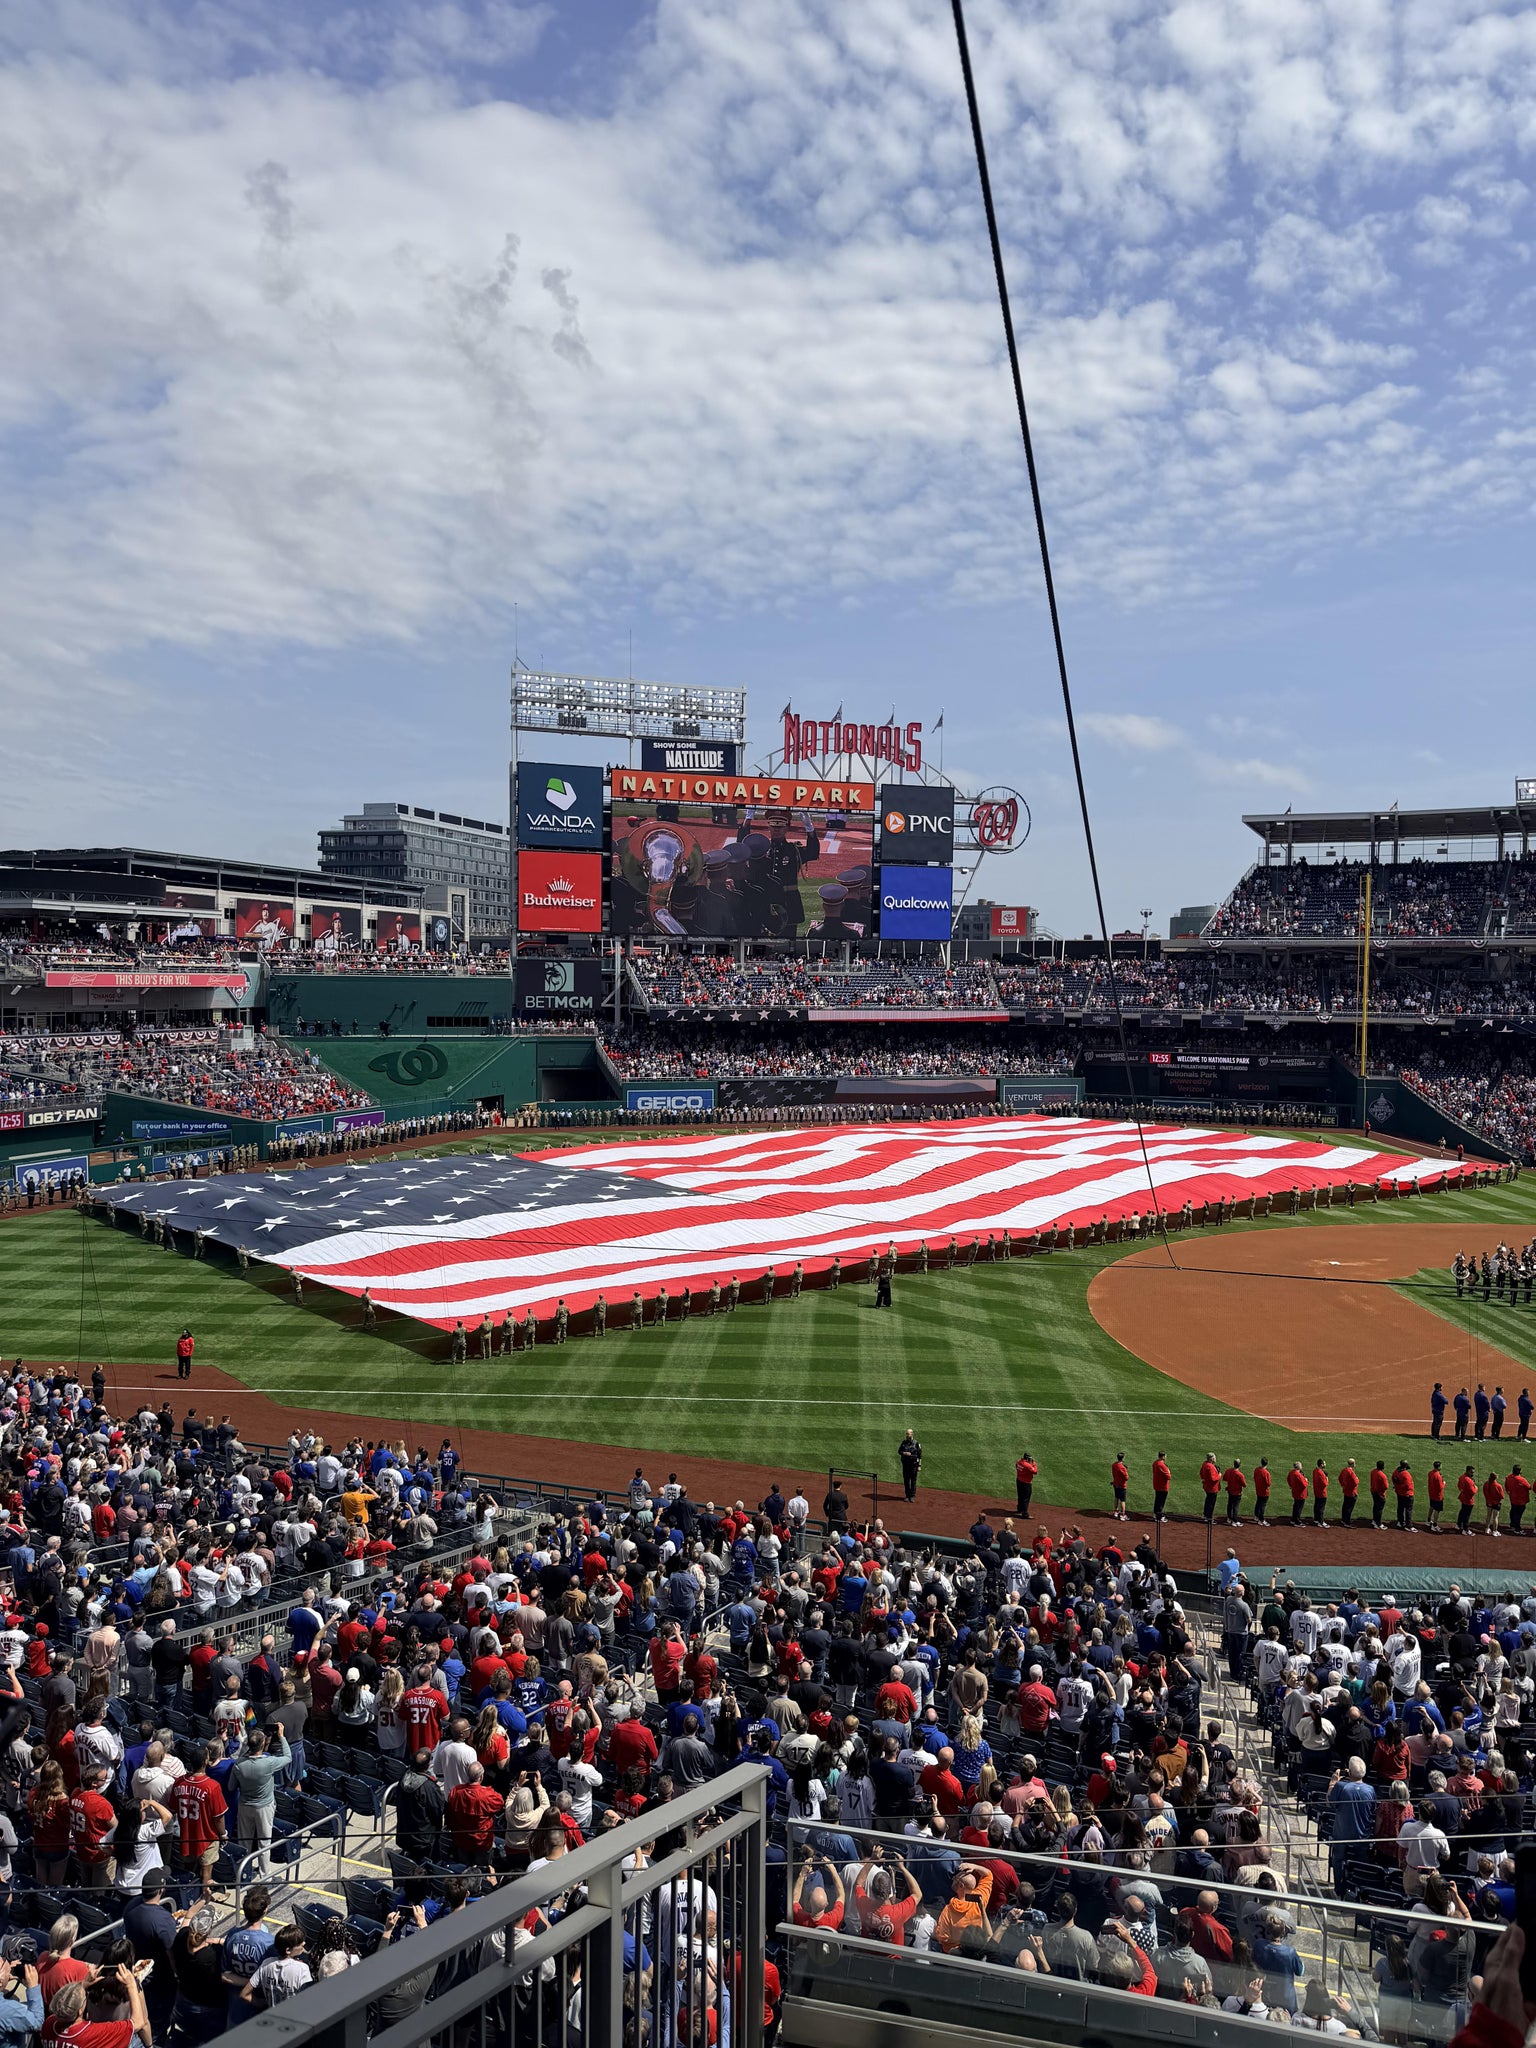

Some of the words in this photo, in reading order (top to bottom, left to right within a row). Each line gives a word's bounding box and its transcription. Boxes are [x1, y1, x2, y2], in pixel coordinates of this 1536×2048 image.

[784, 713, 922, 772] NATIONALS
[665, 750, 724, 768] NATITUDE
[622, 776, 781, 799] NATIONALS
[796, 786, 861, 804] PARK
[526, 813, 596, 828] VANDA
[908, 814, 951, 833] PNC
[529, 826, 582, 834] PHARMACEUTICALS
[524, 893, 596, 907] Budweiser
[884, 896, 949, 910] Qualcomm
[115, 974, 133, 985] THIS
[134, 975, 157, 985] BUD'S
[159, 975, 173, 985] FOR
[175, 975, 191, 985] YOU.
[525, 996, 593, 1008] BETMGM
[1152, 1054, 1169, 1063] 12:55
[1177, 1055, 1200, 1063] WELCOME
[1238, 1083, 1270, 1091] verizon
[637, 1096, 703, 1110] GEICO
[66, 1107, 97, 1121] FAN
[0, 1114, 21, 1129] 12:55
[143, 1146, 152, 1157] 377
[443, 1458, 454, 1466] 50
[1010, 1569, 1022, 1579] 22
[1299, 1622, 1312, 1634] 50
[1265, 1653, 1276, 1665] 17
[1332, 1657, 1343, 1669] 16
[522, 1691, 537, 1707] 22
[380, 1711, 395, 1727] 31
[411, 1708, 430, 1724] 37
[1374, 1709, 1380, 1720] 5
[792, 1747, 809, 1761] 17
[567, 1781, 576, 1797] 5
[179, 1799, 200, 1821] 63
[1146, 1827, 1173, 1838] SNIDER
